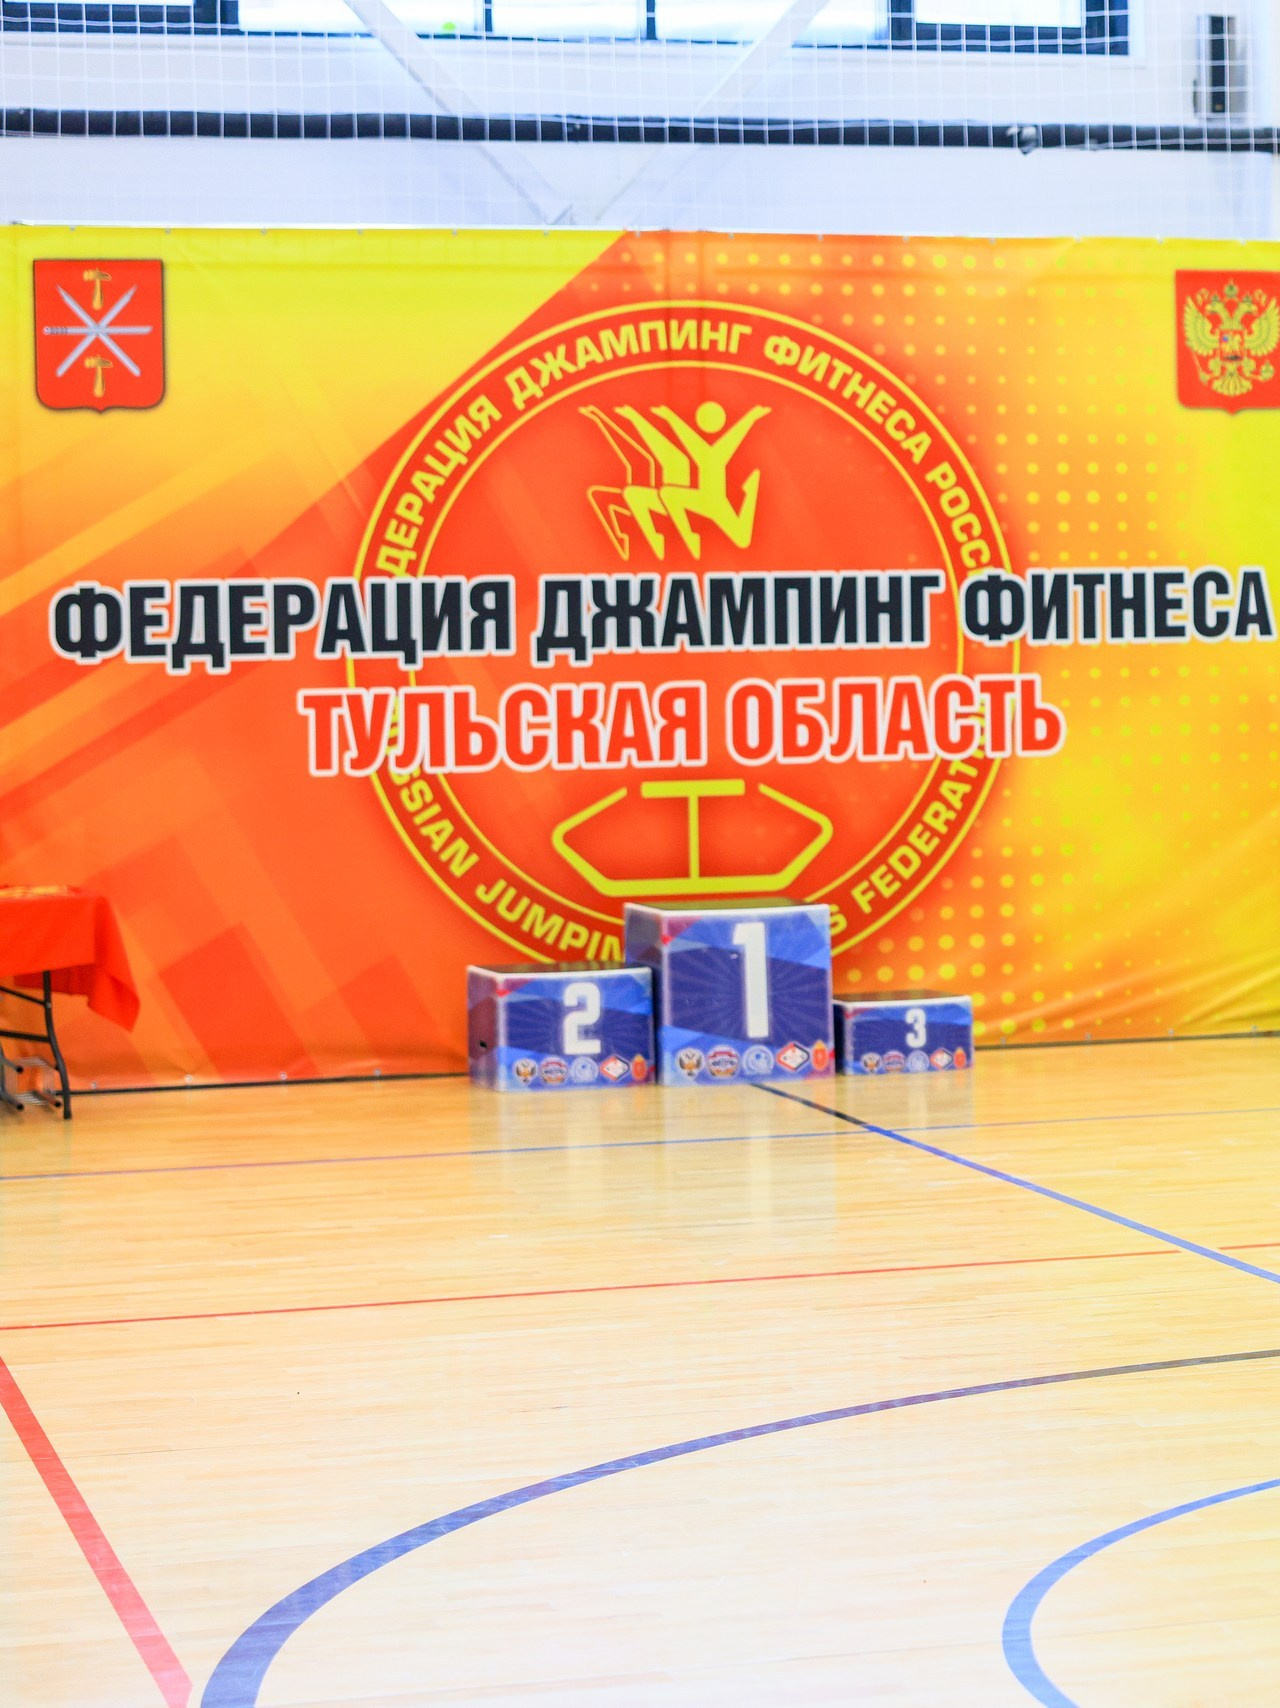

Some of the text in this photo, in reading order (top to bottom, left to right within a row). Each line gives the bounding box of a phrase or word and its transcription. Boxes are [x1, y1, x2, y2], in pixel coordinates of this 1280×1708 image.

[376, 319, 995, 577] ДЕРАЦИЯ ДЖАМПИНГ ФИТНЕСА РОСС
[51, 566, 1276, 673] ФЕДЕРАЦИЯ ДЖАМПИНГ ФИТНЕСА
[300, 674, 1067, 775] ТУЛЬСКАЯ ОБЛАСТЬ
[475, 877, 624, 961] JUMPIN
[851, 745, 986, 914] FEDERAT
[563, 982, 601, 1055] 2
[732, 921, 769, 1038] 1
[905, 1008, 927, 1048] 3
